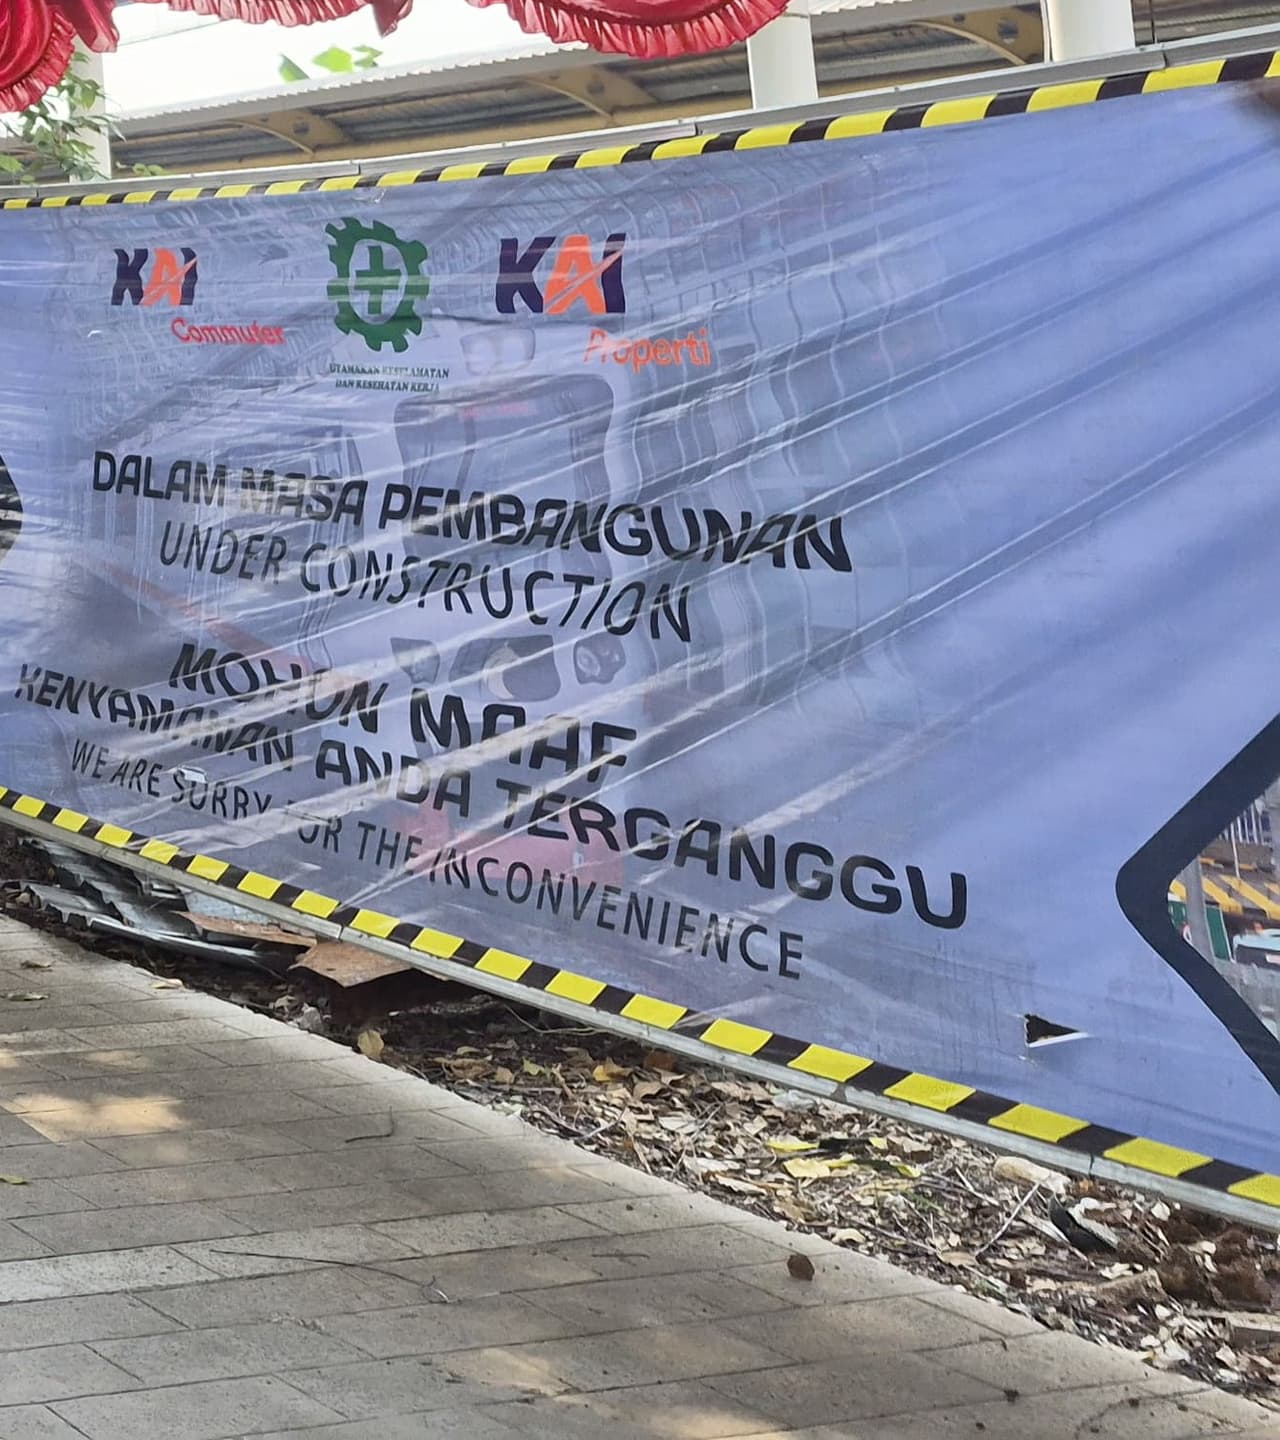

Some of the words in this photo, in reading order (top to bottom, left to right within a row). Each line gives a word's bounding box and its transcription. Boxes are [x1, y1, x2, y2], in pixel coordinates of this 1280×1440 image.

[110, 247, 198, 308] KAI
[495, 232, 627, 316] KAI
[170, 316, 287, 346] Commuter
[582, 327, 712, 377] Properti
[92, 450, 228, 507] DALAM
[239, 466, 369, 527] MASA
[377, 482, 853, 573] PEMBANGUNAN
[159, 520, 288, 585] UNDER
[299, 542, 693, 643] CONSTRUCTION
[409, 687, 638, 784] MAAF
[70, 738, 109, 779] WE
[111, 748, 164, 798] ARE
[357, 821, 423, 877] THE
[428, 846, 804, 980] INCONVENIENCE
[315, 738, 472, 818] ANDA
[495, 778, 969, 930] TERGANGGU
